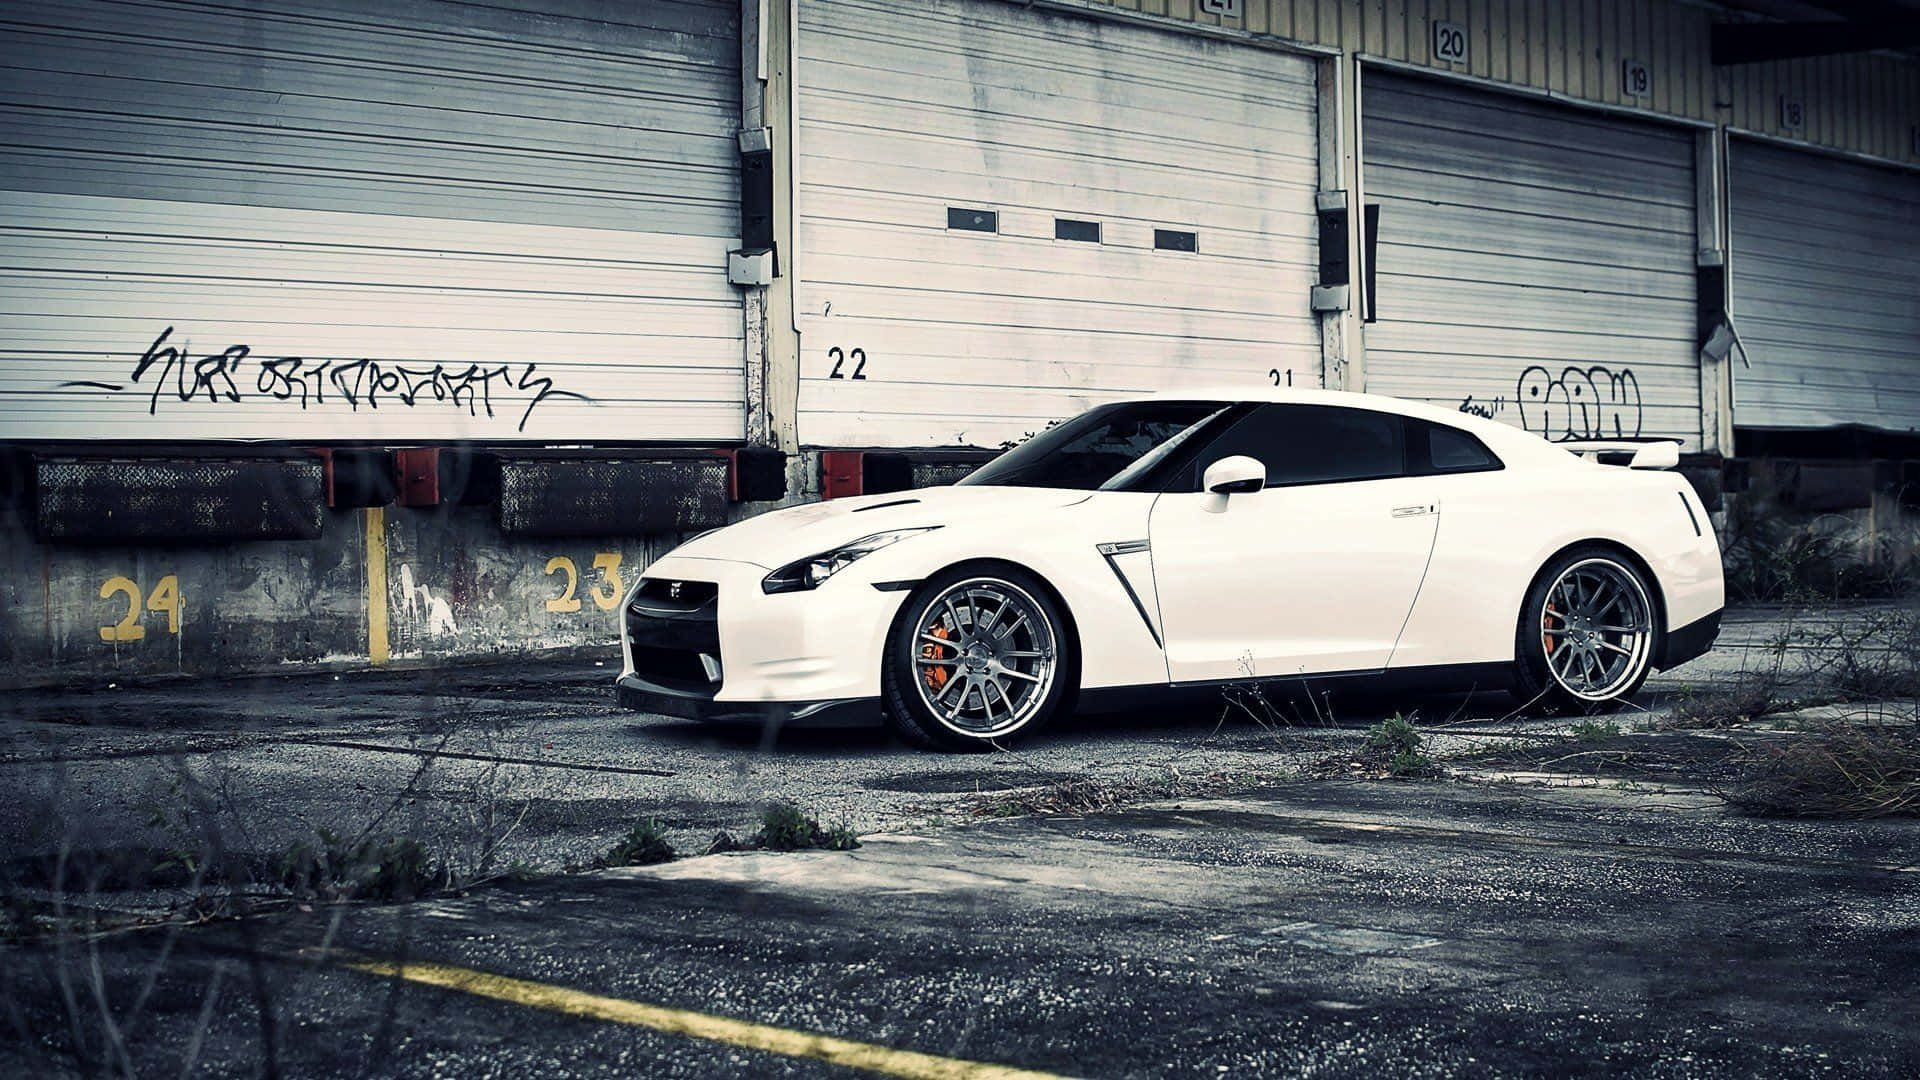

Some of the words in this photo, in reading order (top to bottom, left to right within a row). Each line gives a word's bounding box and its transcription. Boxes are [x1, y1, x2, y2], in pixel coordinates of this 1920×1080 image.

[1440, 28, 1464, 58] 20
[1631, 67, 1647, 92] 19
[1786, 103, 1801, 126] 18
[828, 346, 867, 380] 22
[544, 552, 624, 613] 23
[100, 575, 186, 641] 24
